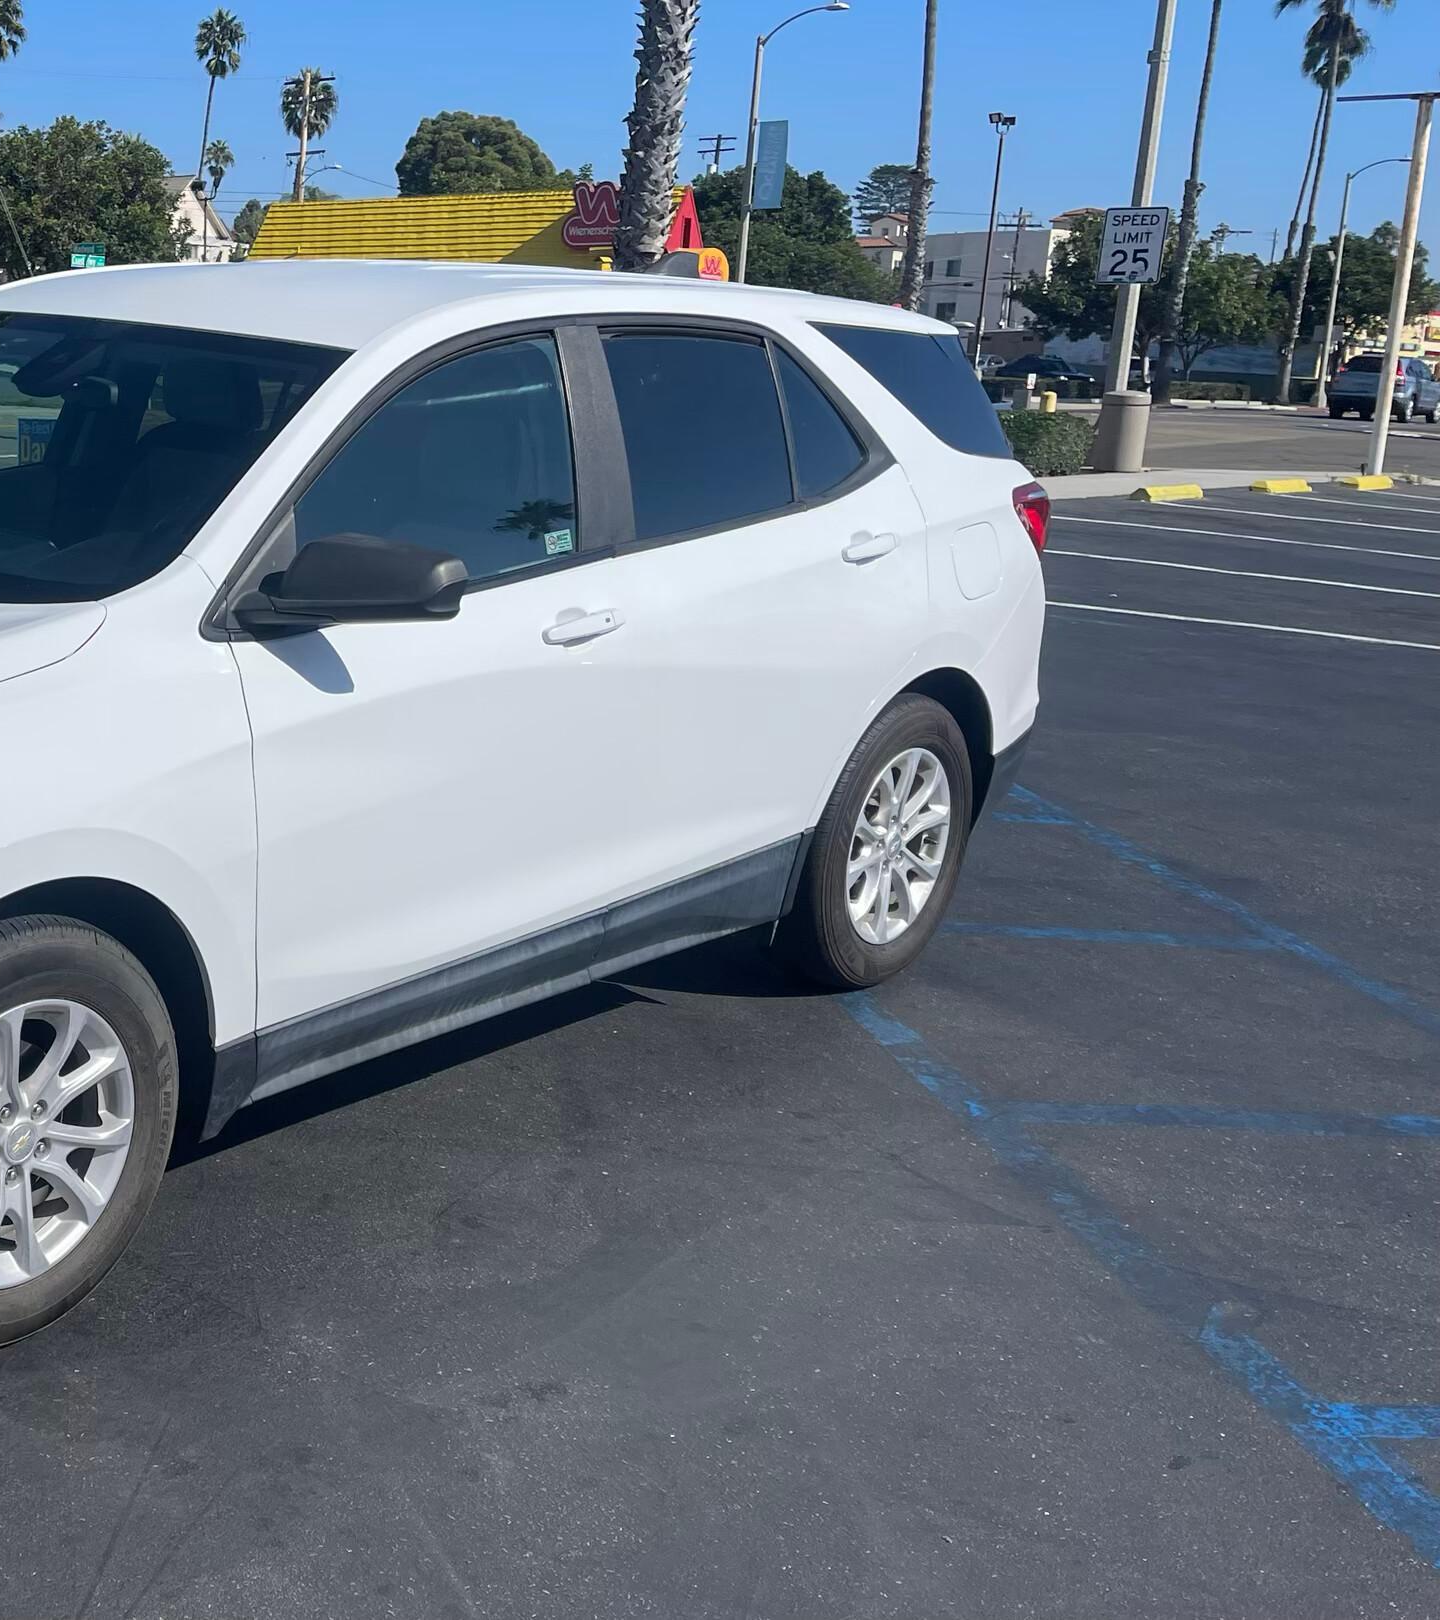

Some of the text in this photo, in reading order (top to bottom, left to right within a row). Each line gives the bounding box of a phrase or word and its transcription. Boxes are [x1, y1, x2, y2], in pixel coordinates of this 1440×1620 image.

[1112, 214, 1160, 226] SPEED
[1113, 231, 1153, 244] LIMIT
[1108, 248, 1149, 276] 25
